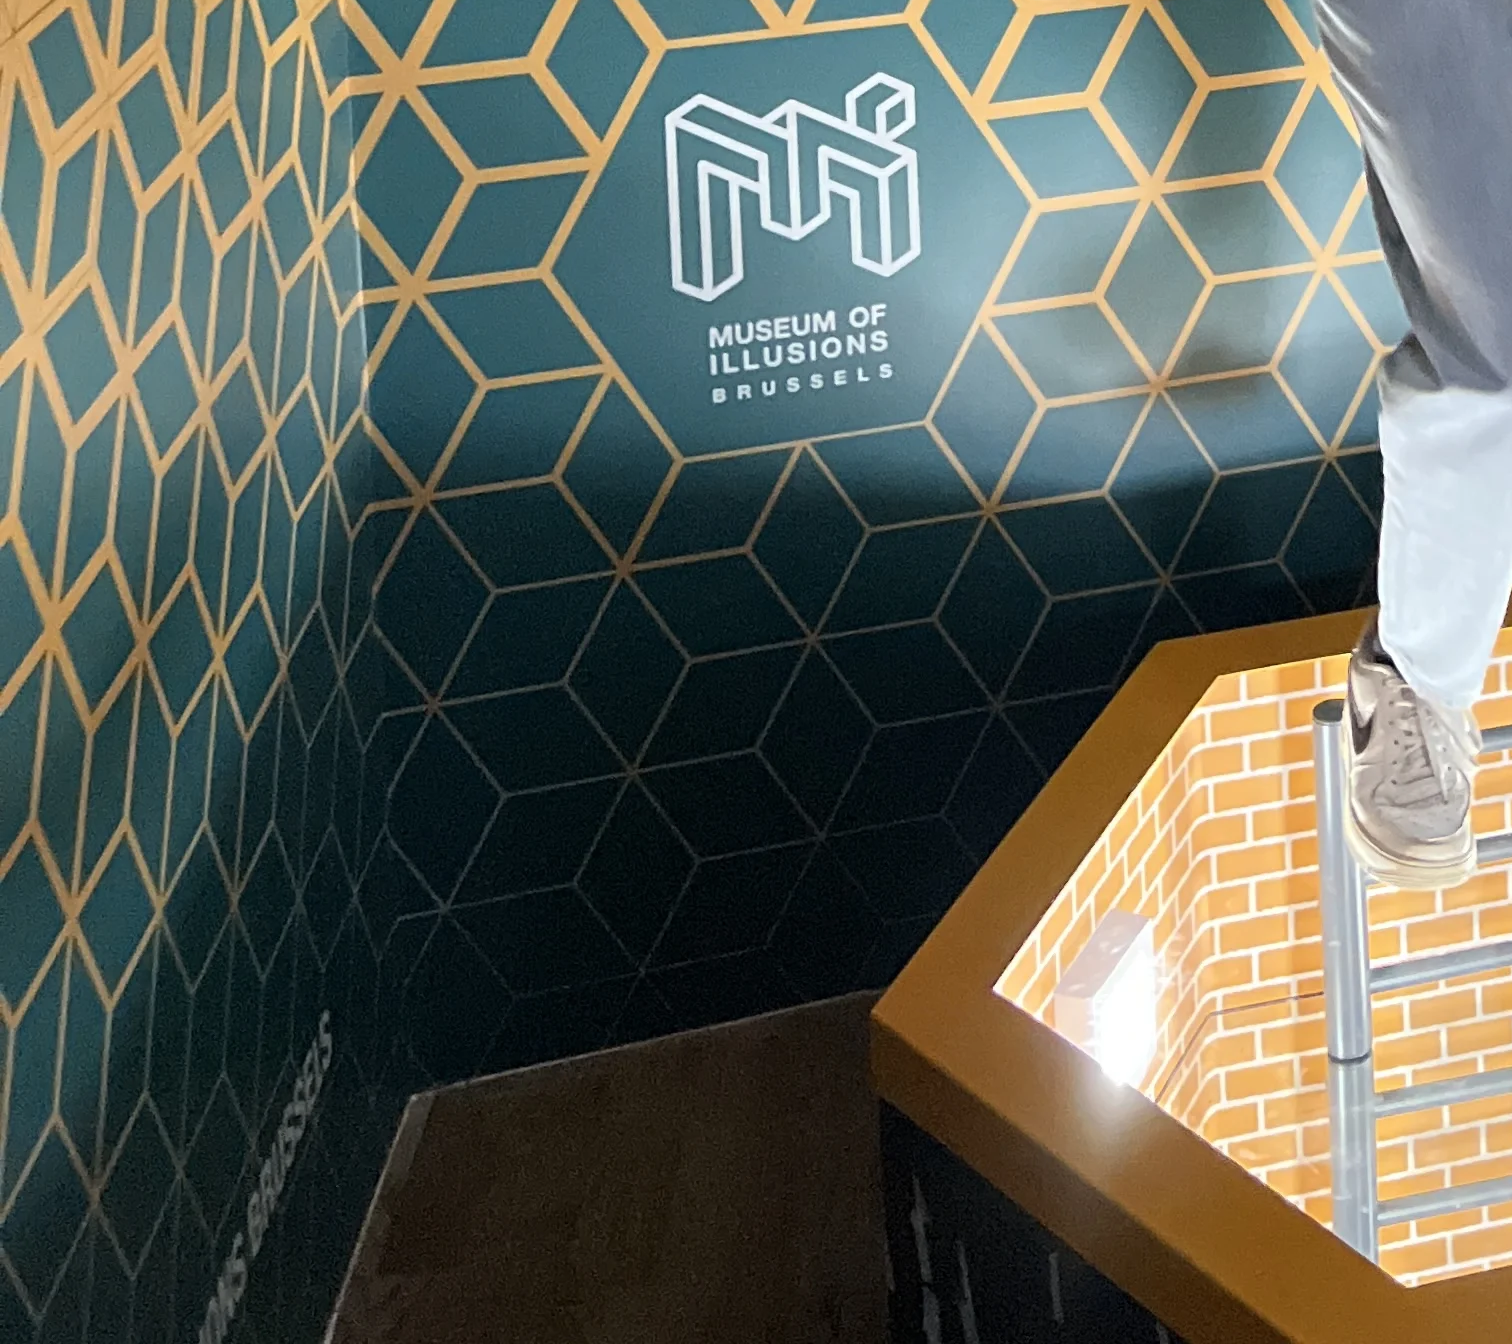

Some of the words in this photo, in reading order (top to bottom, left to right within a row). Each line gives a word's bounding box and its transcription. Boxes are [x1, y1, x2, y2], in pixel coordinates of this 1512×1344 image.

[708, 310, 837, 349] MUSEUM
[849, 303, 888, 331] OF
[709, 330, 889, 376] ILLUSIONS
[711, 363, 894, 404] BRUSSELS
[247, 1009, 333, 1258] BRUSSELS
